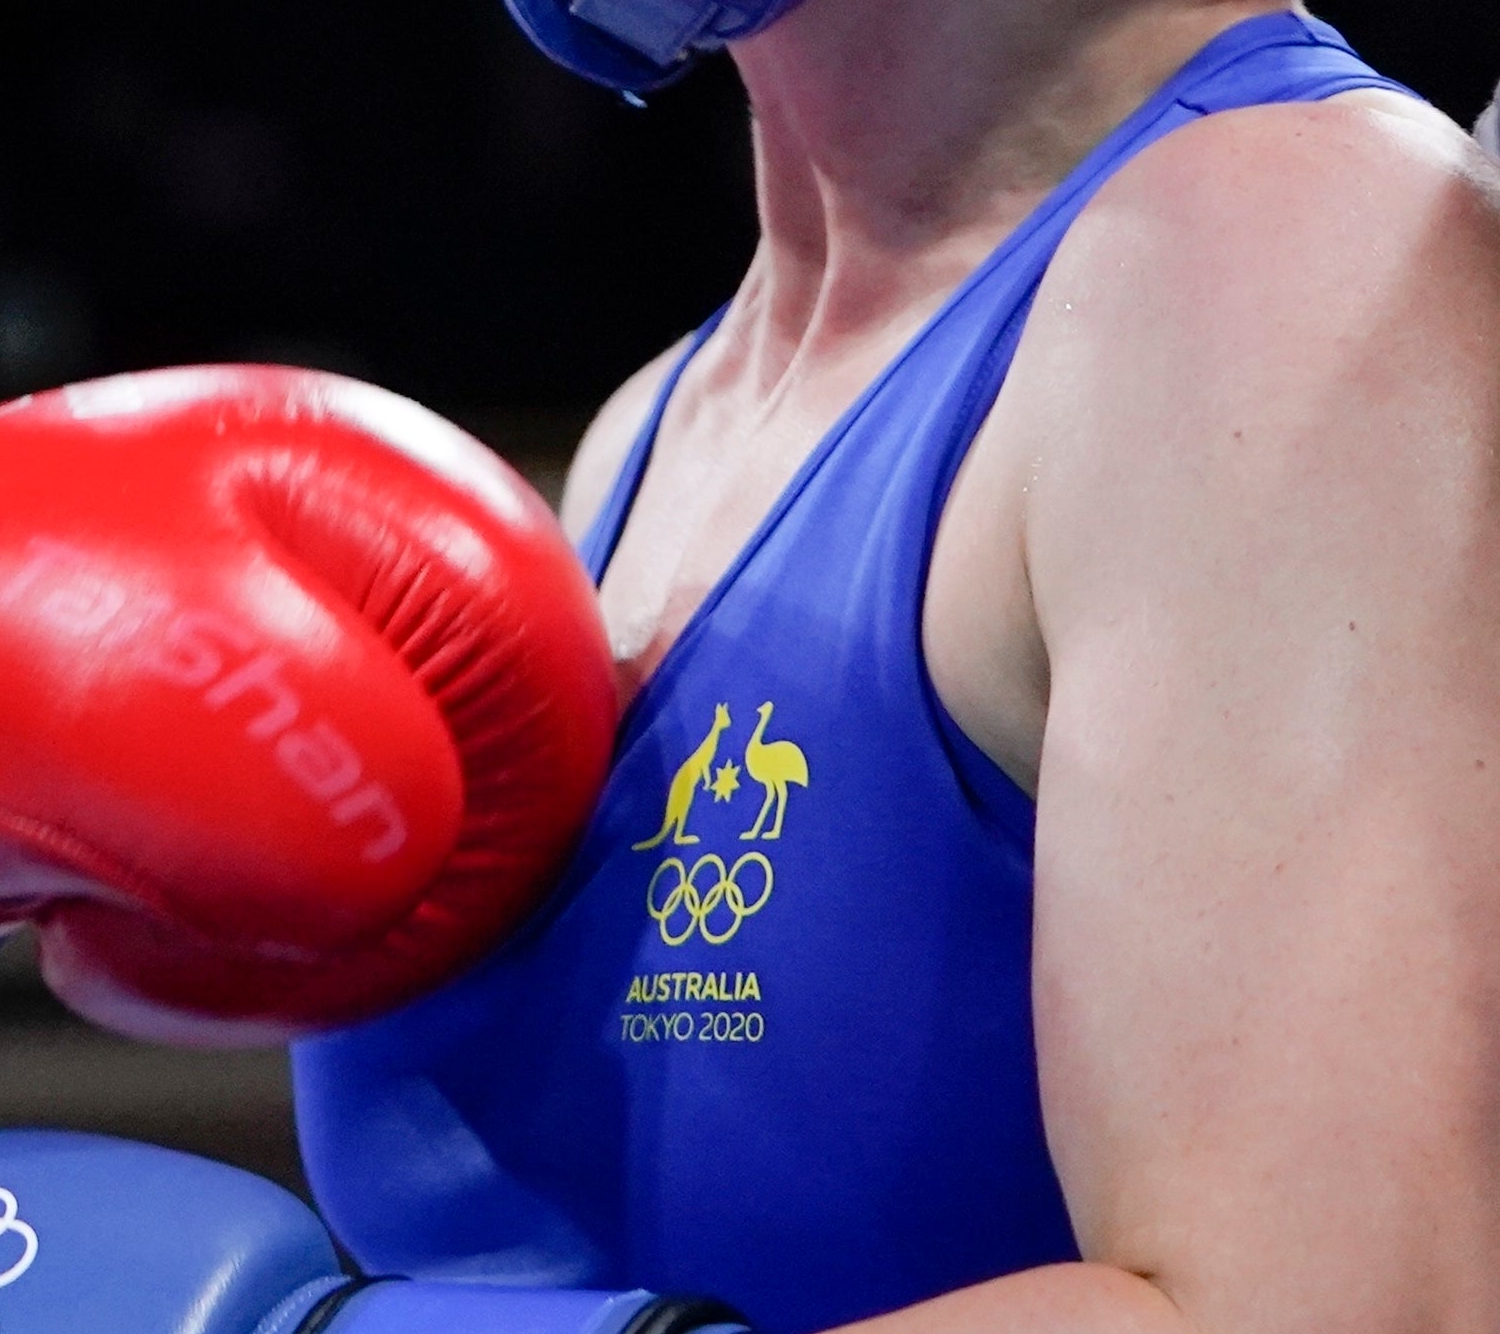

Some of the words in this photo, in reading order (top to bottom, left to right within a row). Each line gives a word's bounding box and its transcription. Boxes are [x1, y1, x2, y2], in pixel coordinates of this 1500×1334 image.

[626, 972, 761, 1003] AUSTRALIA
[621, 1012, 694, 1042] TOKYO
[699, 1012, 765, 1042] 2020
